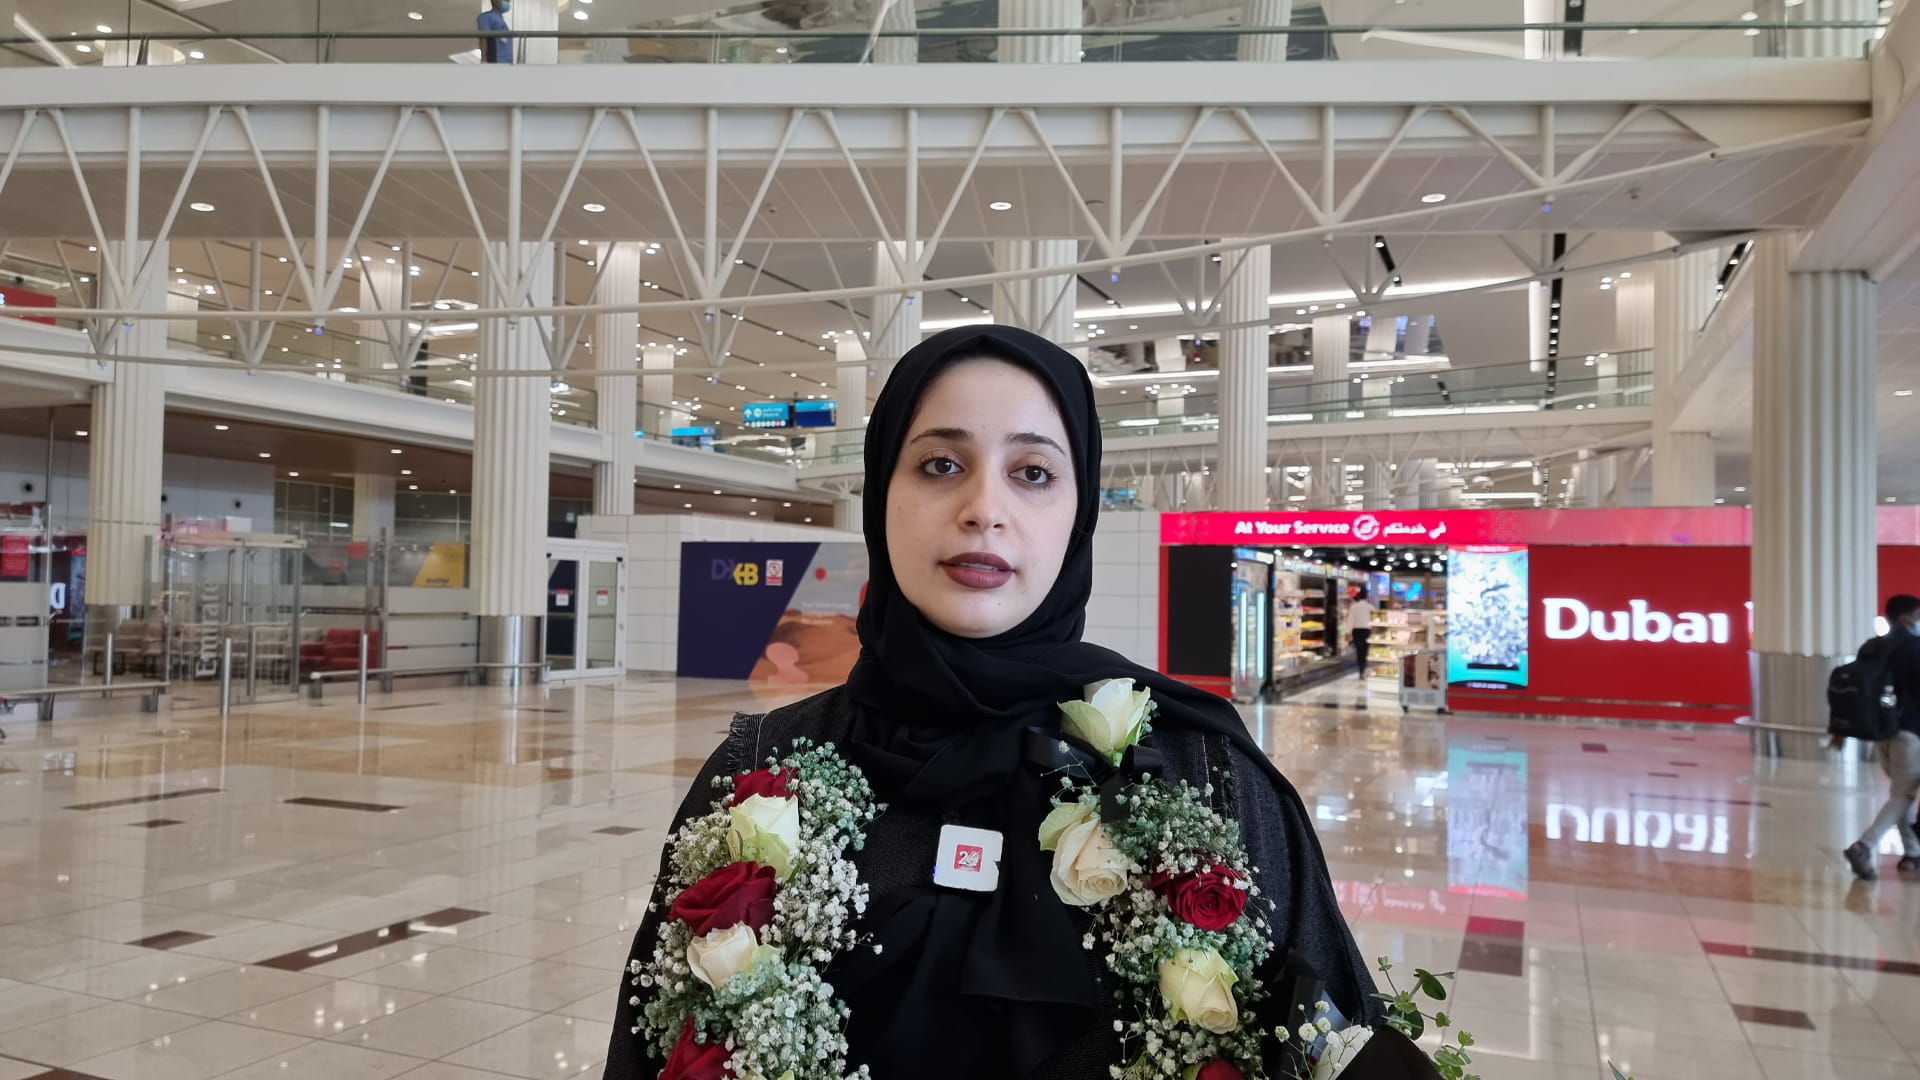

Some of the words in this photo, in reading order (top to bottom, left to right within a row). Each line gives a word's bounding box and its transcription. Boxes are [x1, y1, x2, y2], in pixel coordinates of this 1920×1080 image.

[1255, 521, 1291, 534] Your
[1293, 520, 1350, 534] Service
[196, 583, 219, 677] Emirate
[1542, 597, 1730, 644] Dubai
